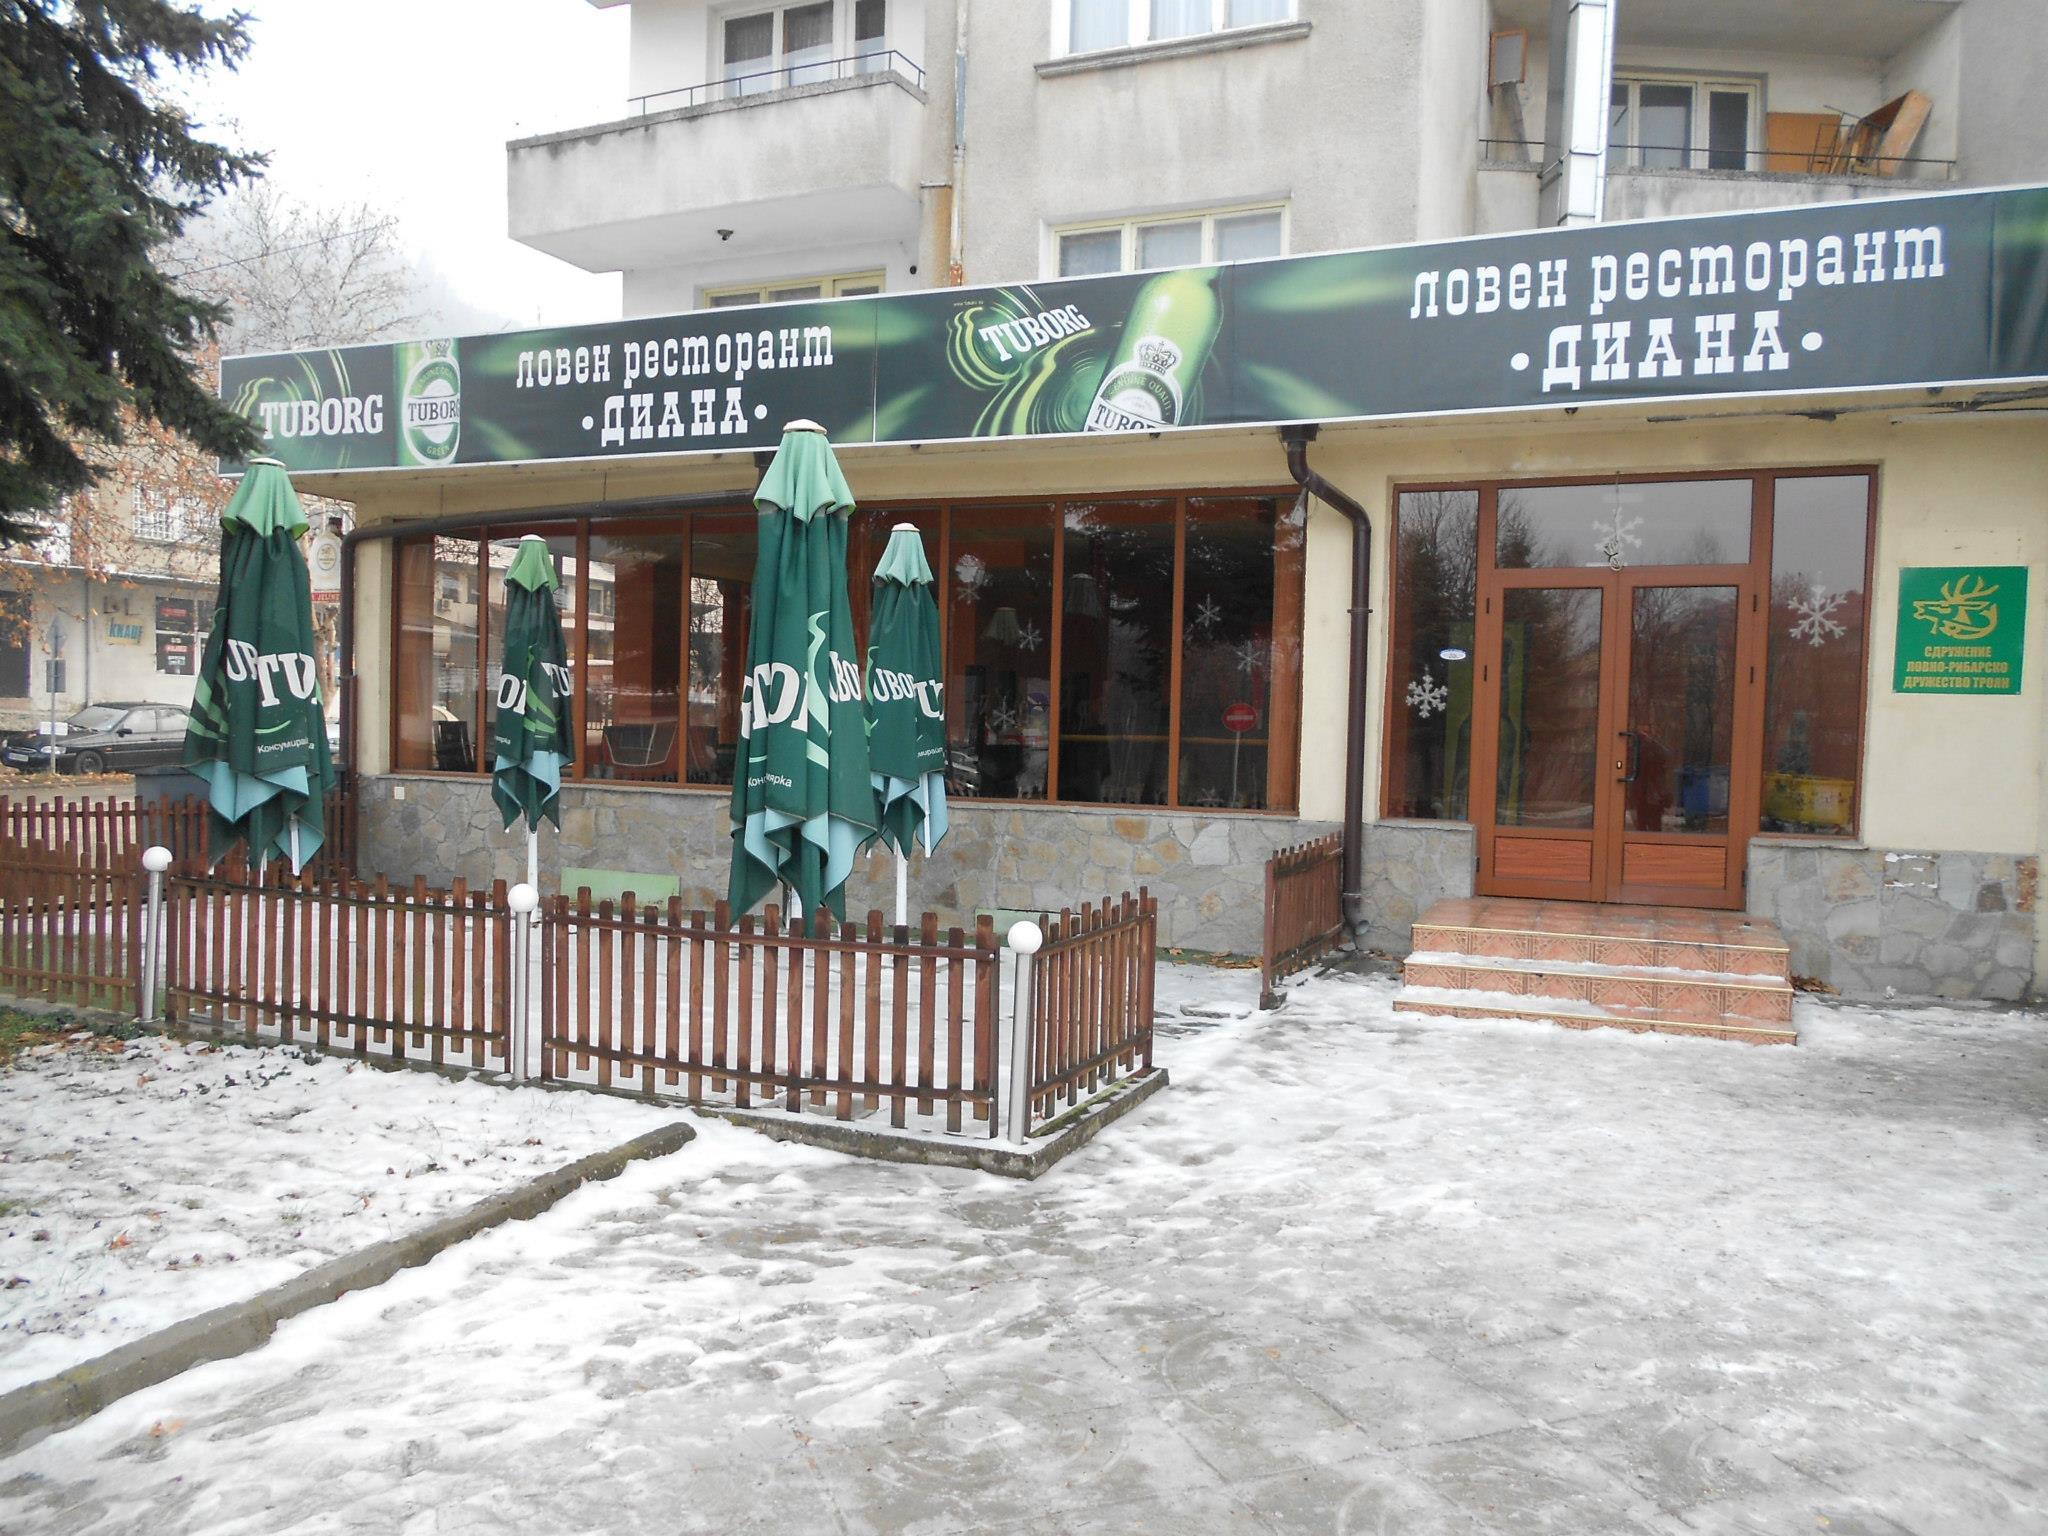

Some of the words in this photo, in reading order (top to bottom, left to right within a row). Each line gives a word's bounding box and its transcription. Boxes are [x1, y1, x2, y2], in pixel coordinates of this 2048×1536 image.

[1410, 258, 1568, 319] ловен
[1589, 225, 1945, 316] ресторант
[516, 344, 611, 389] ловен
[623, 324, 834, 389] ресторант
[978, 304, 1091, 362] TUBORG
[1542, 309, 1790, 393] ДИАНА
[259, 394, 383, 439] TUBORG
[600, 386, 748, 447] ДИАНА
